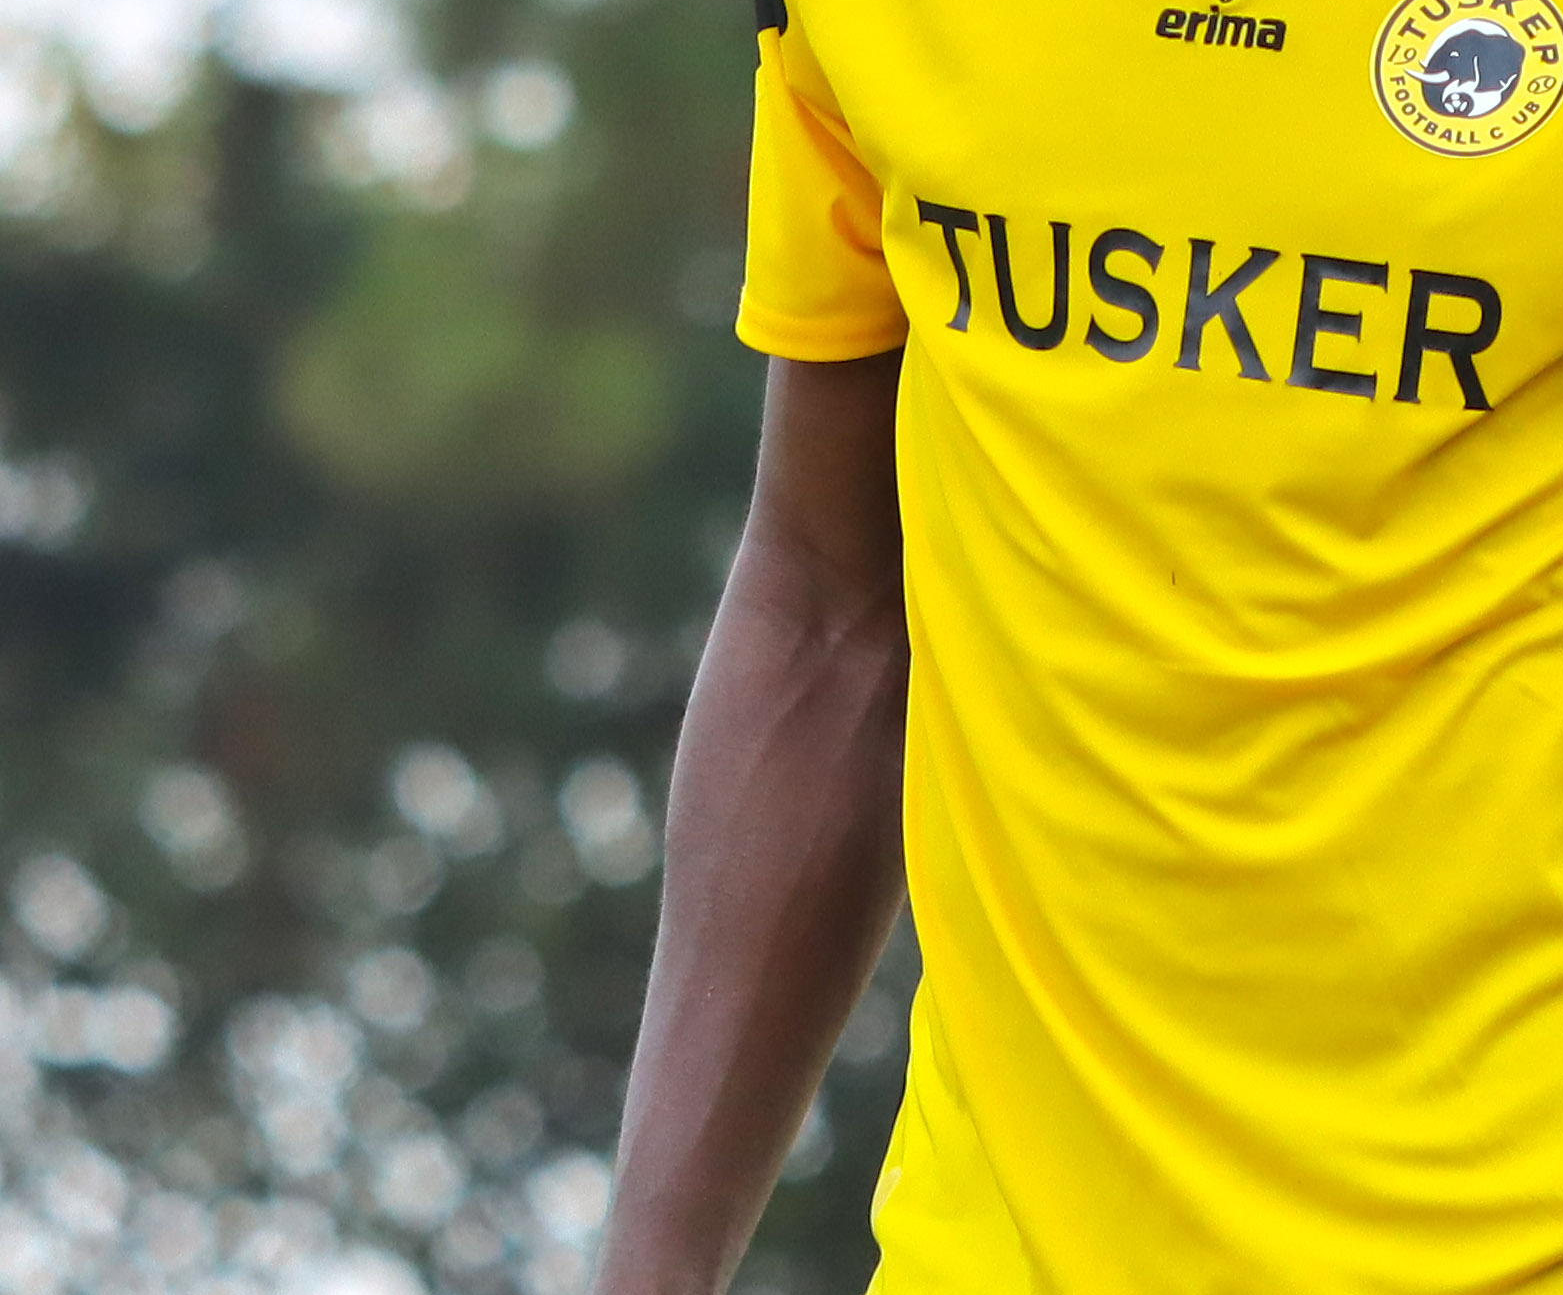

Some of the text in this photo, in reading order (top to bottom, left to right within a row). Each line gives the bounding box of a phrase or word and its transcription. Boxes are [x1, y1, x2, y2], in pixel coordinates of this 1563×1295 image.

[1155, 4, 1287, 52] erima
[1389, 75, 1540, 144] FOOTBALL CUB
[914, 198, 1504, 413] TUSKER
